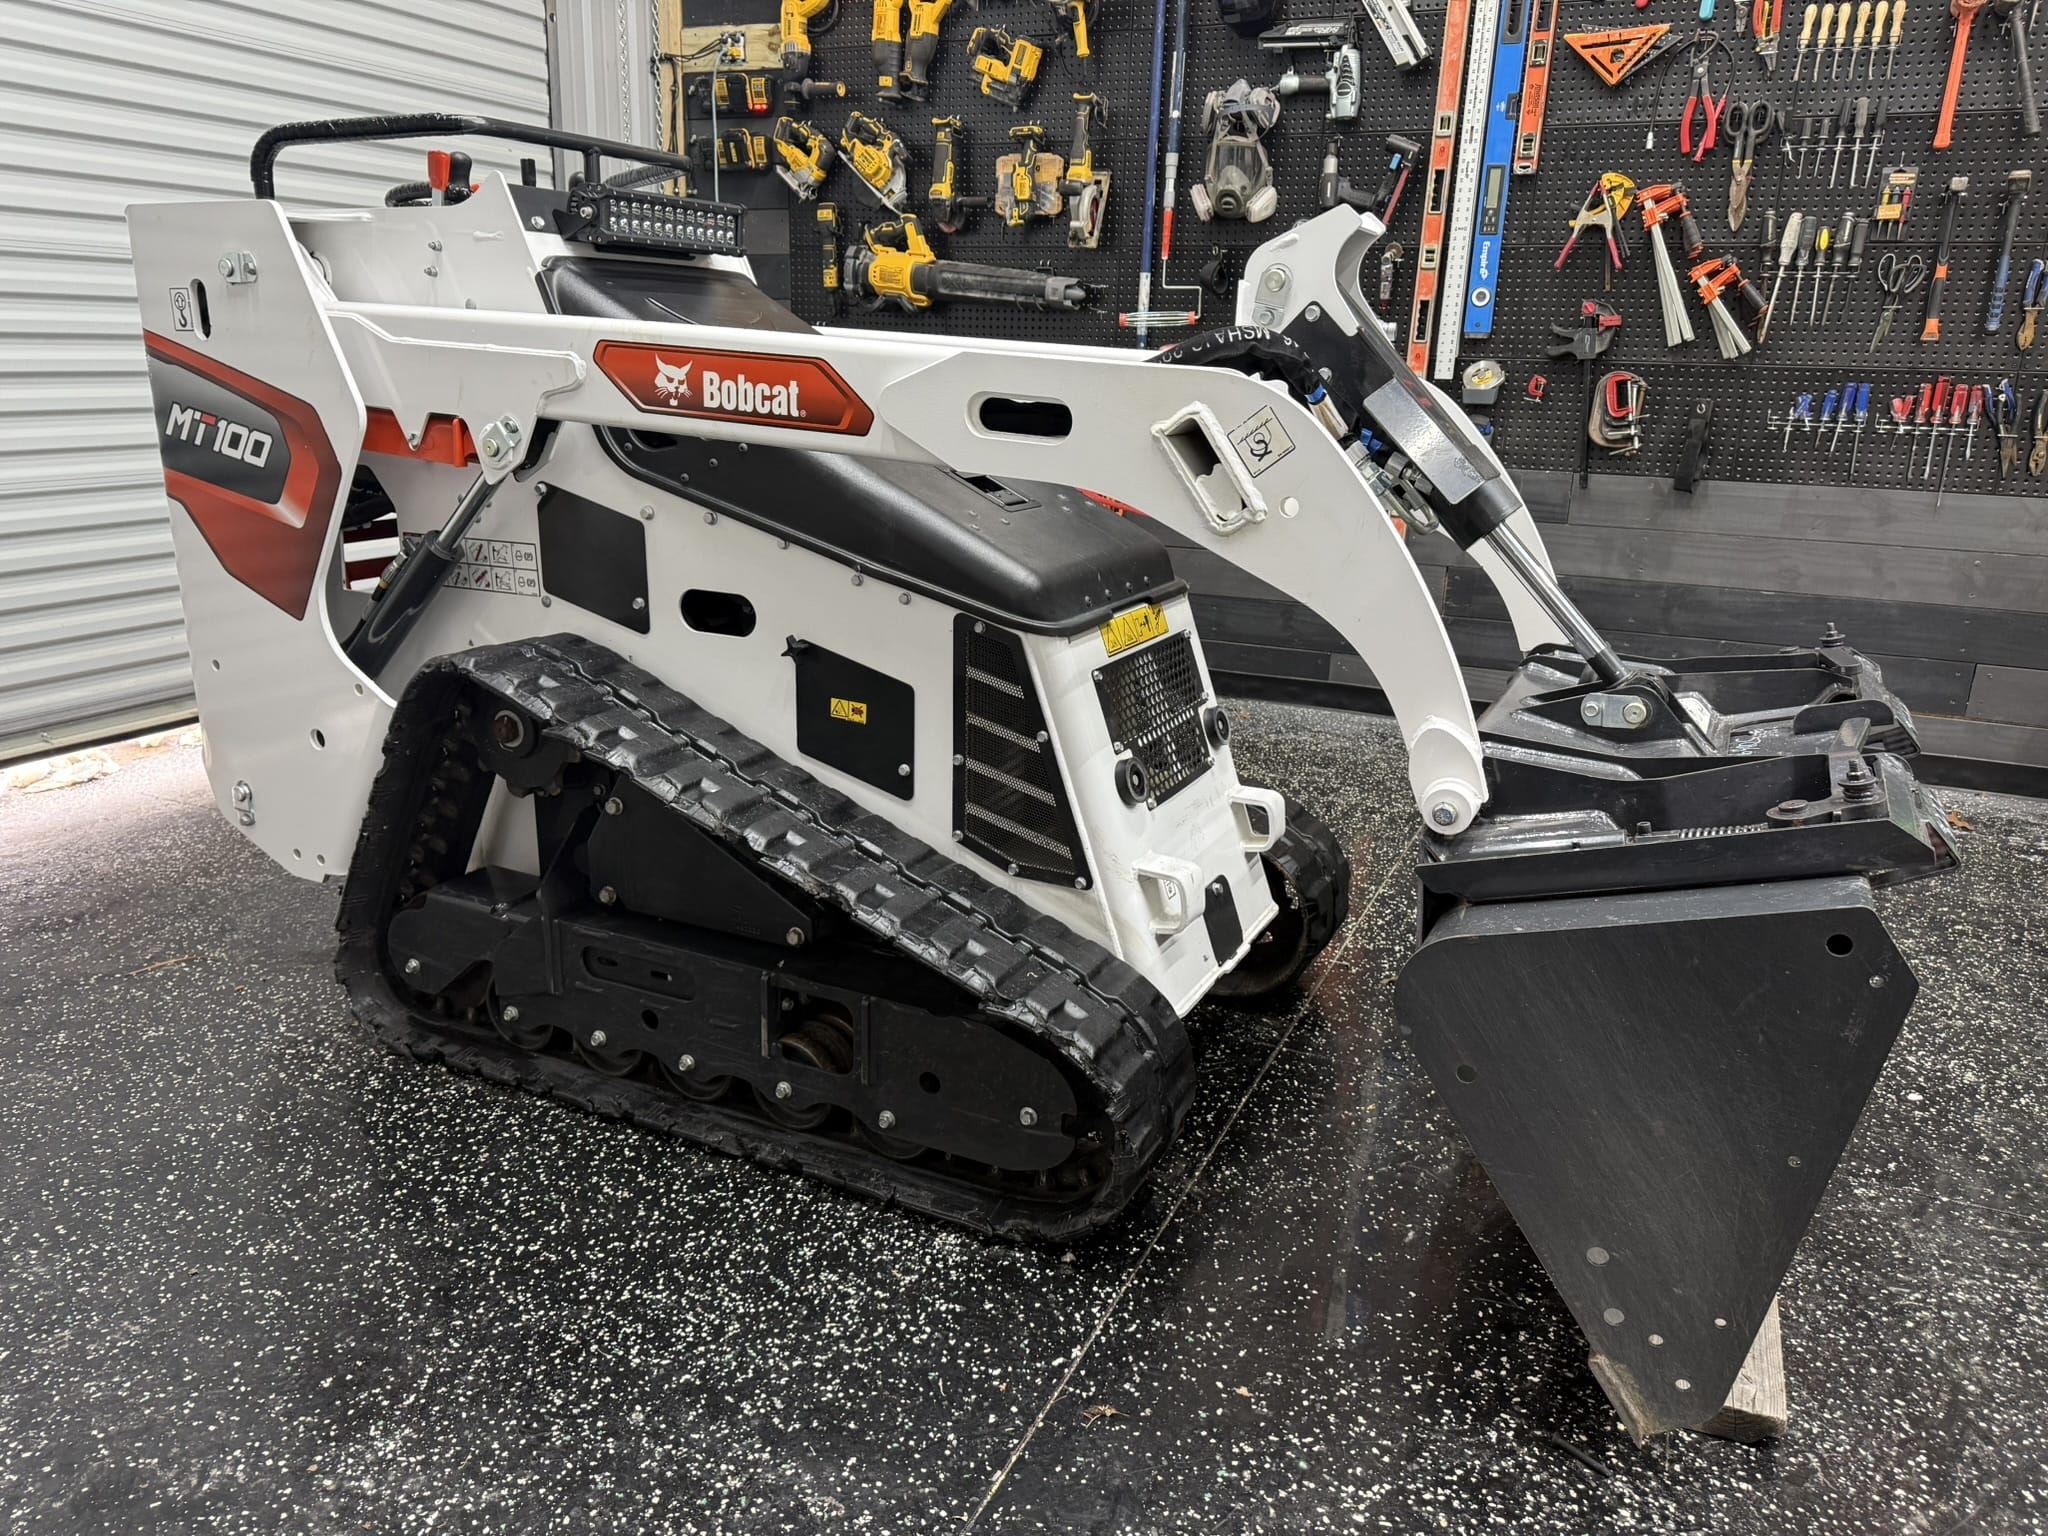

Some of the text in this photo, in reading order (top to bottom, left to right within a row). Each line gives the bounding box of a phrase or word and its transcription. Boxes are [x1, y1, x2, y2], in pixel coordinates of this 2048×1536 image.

[1479, 241, 1491, 280] Empire
[702, 370, 800, 417] Bobcat
[165, 403, 273, 469] MT100
